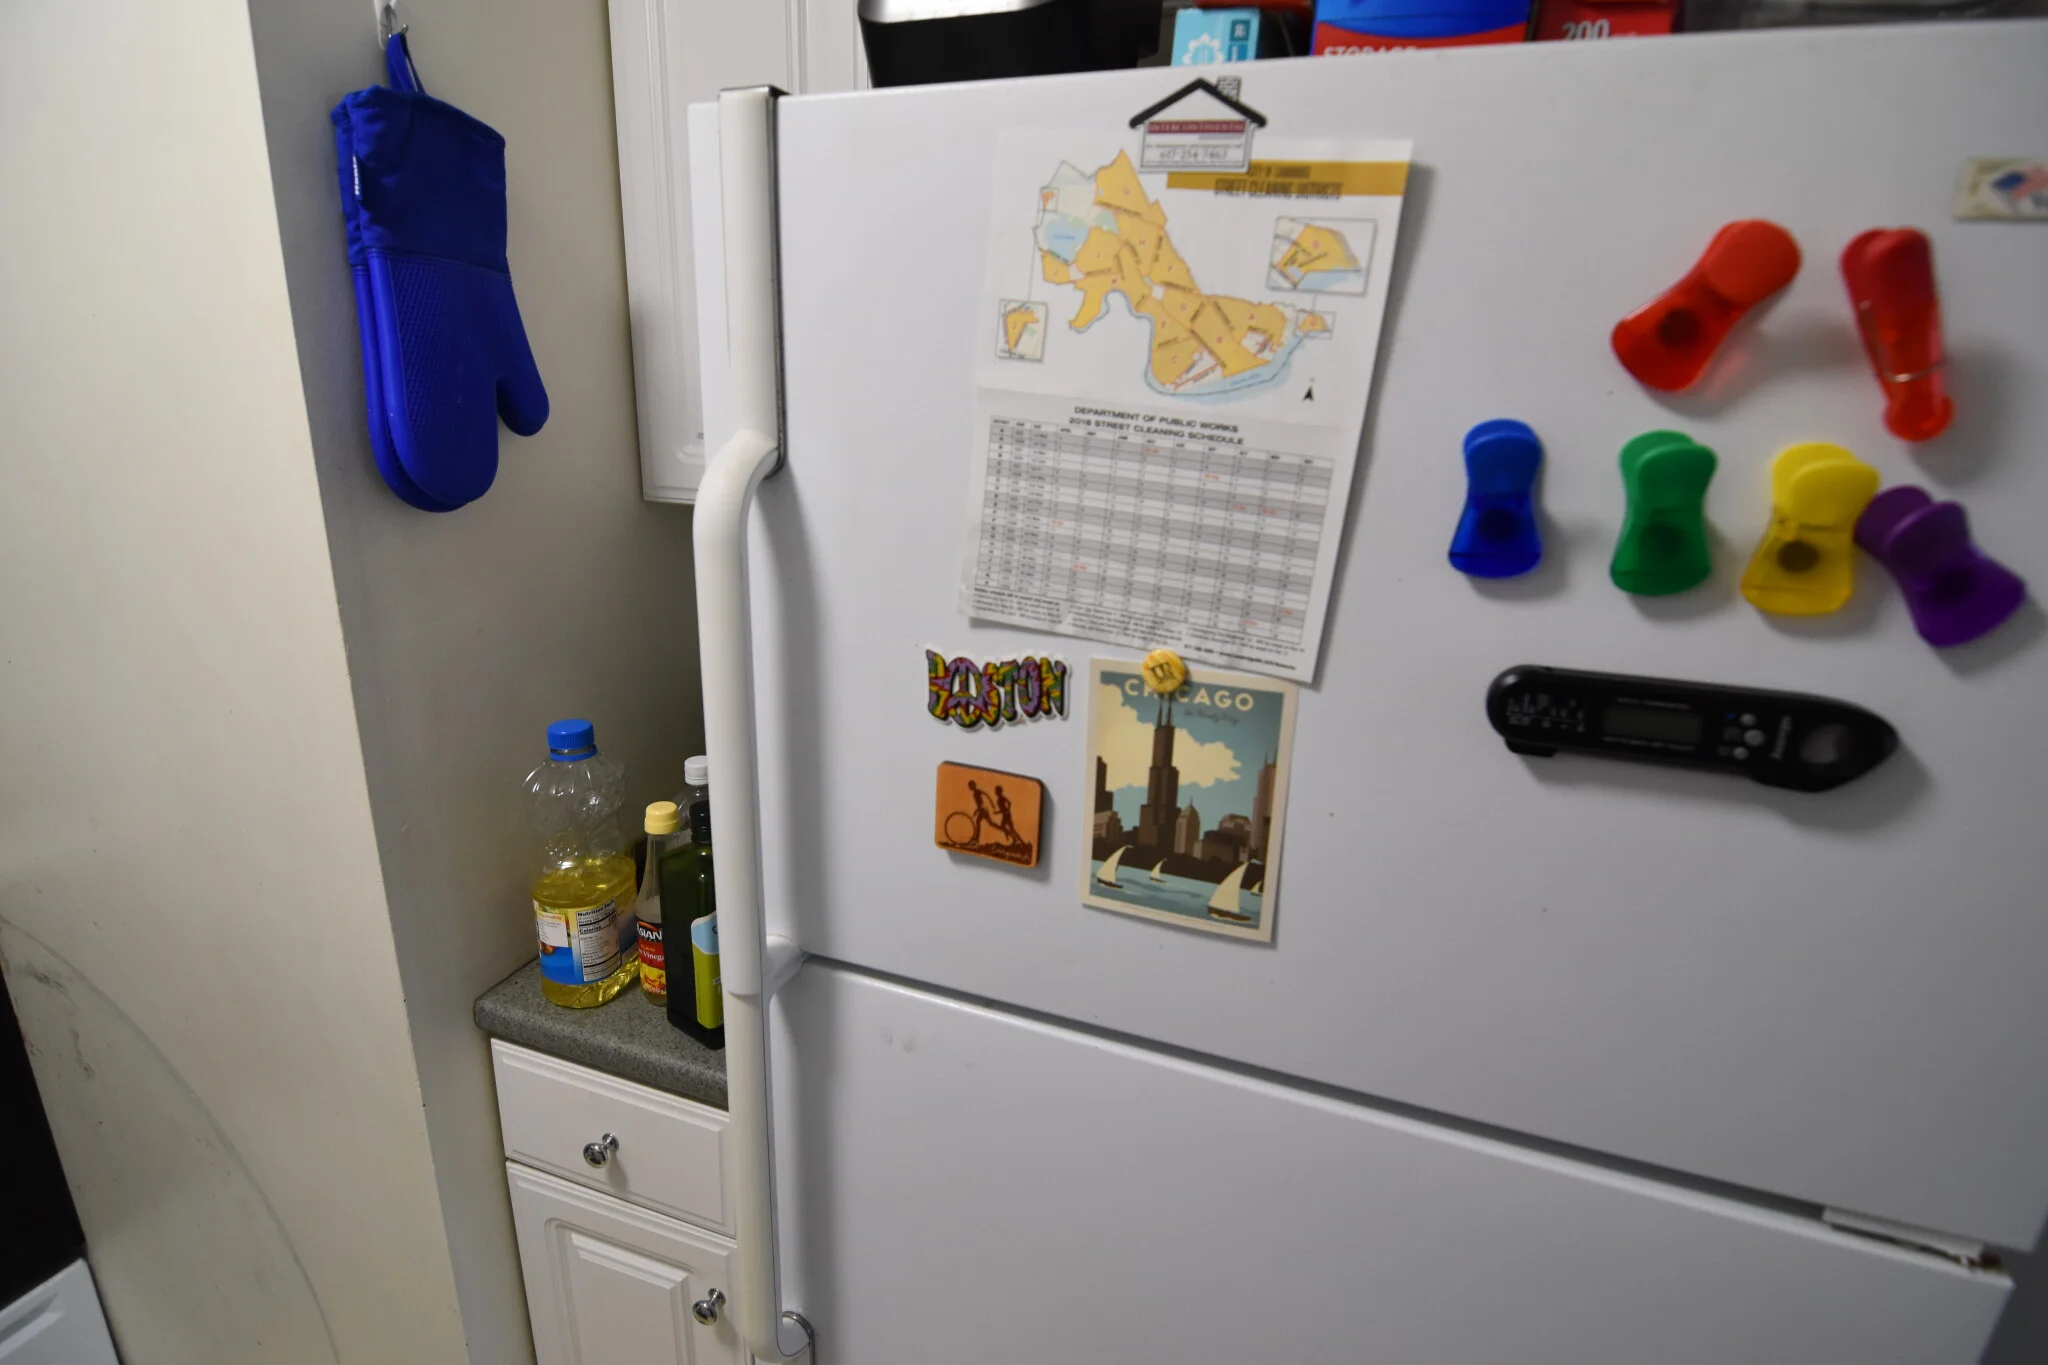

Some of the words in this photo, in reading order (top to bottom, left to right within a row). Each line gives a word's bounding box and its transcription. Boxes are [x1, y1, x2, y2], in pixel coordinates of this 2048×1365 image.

[1562, 18, 1611, 41] 200
[1074, 406, 1141, 421] DEPARTMENT
[1142, 414, 1156, 423] OF
[1159, 416, 1197, 428] PUBLIC
[1199, 421, 1239, 433] WORKS
[1094, 420, 1131, 431] STREET
[1133, 424, 1185, 438] CLEANING
[1187, 431, 1244, 445] SCHEDULE
[925, 648, 1067, 728] BOSTON
[1124, 678, 1254, 712] CCAGO
[578, 906, 604, 917] Nutrition
[580, 926, 602, 934] Calories
